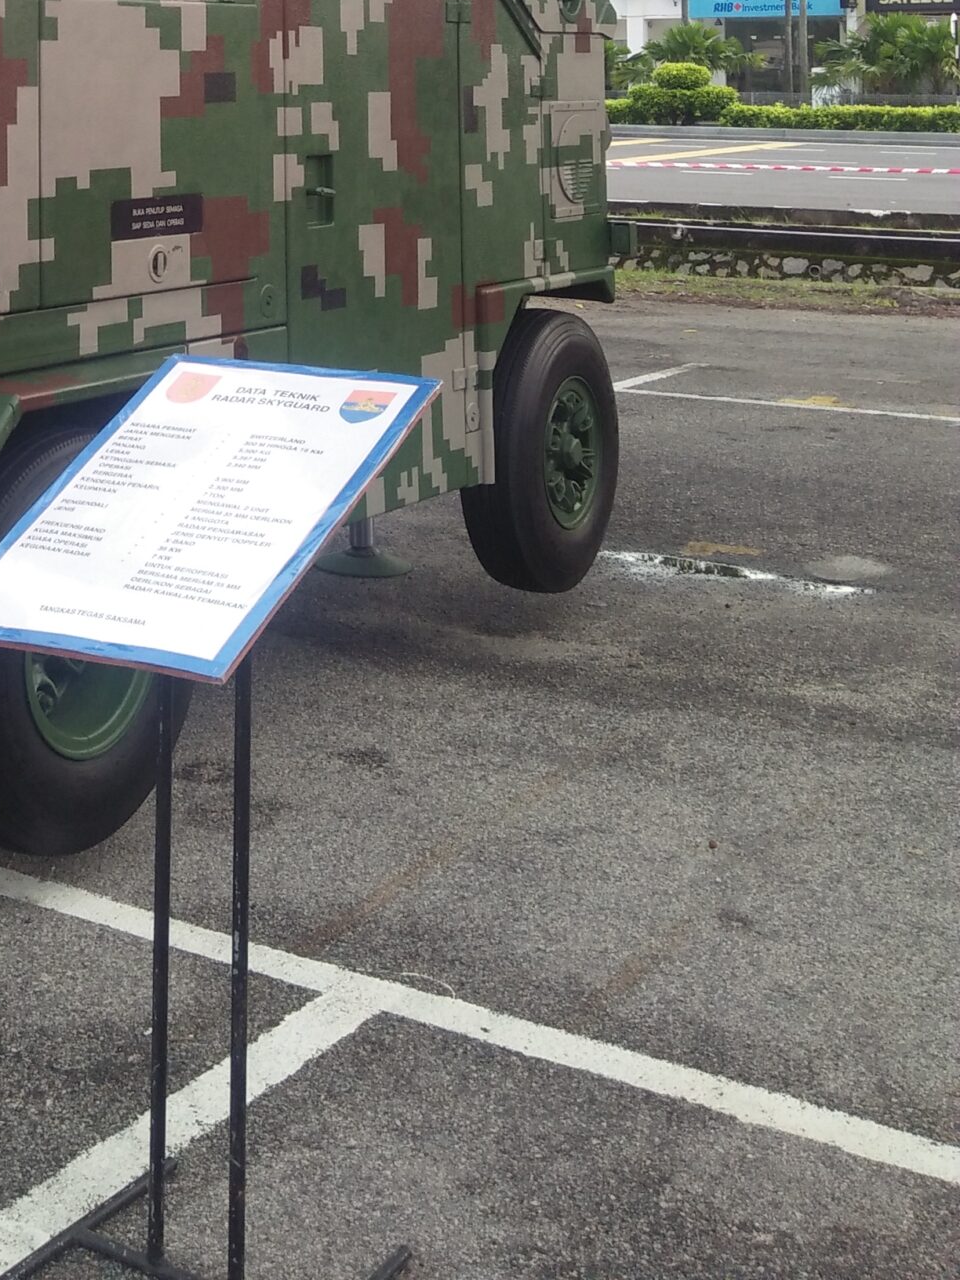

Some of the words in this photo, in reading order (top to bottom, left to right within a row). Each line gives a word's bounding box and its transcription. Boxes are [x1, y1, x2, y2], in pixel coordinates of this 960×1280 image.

[713, 2, 734, 12] RHB
[146, 206, 164, 215] PENUTUP
[131, 222, 141, 230] SIAP
[167, 218, 184, 226] OPERASI
[272, 390, 320, 400] TEKNIK
[212, 394, 256, 404] RADAR
[257, 398, 331, 411] SKYGUARD
[250, 435, 305, 443] SWITZERLAND
[80, 477, 126, 485] KENDERAAN
[61, 498, 108, 507] PENGENDALI
[196, 500, 240, 508] MENGAWAL
[40, 520, 83, 529] FREKUENSI
[250, 515, 292, 524] OERLIKON
[60, 532, 103, 541] MAKSIMUM
[207, 526, 265, 537] PENGAWASAN
[19, 543, 62, 552] KEGUNAAN
[173, 566, 229, 578] BEROPERASI
[137, 570, 178, 579] BERSAMA
[179, 577, 213, 585] MERIAM
[130, 577, 173, 586] OERLIKON
[174, 584, 212, 593] SEBAGAI
[153, 589, 196, 599] KAWALAN
[39, 605, 76, 614] TANGKAS
[104, 614, 147, 625] SAKSAMA
